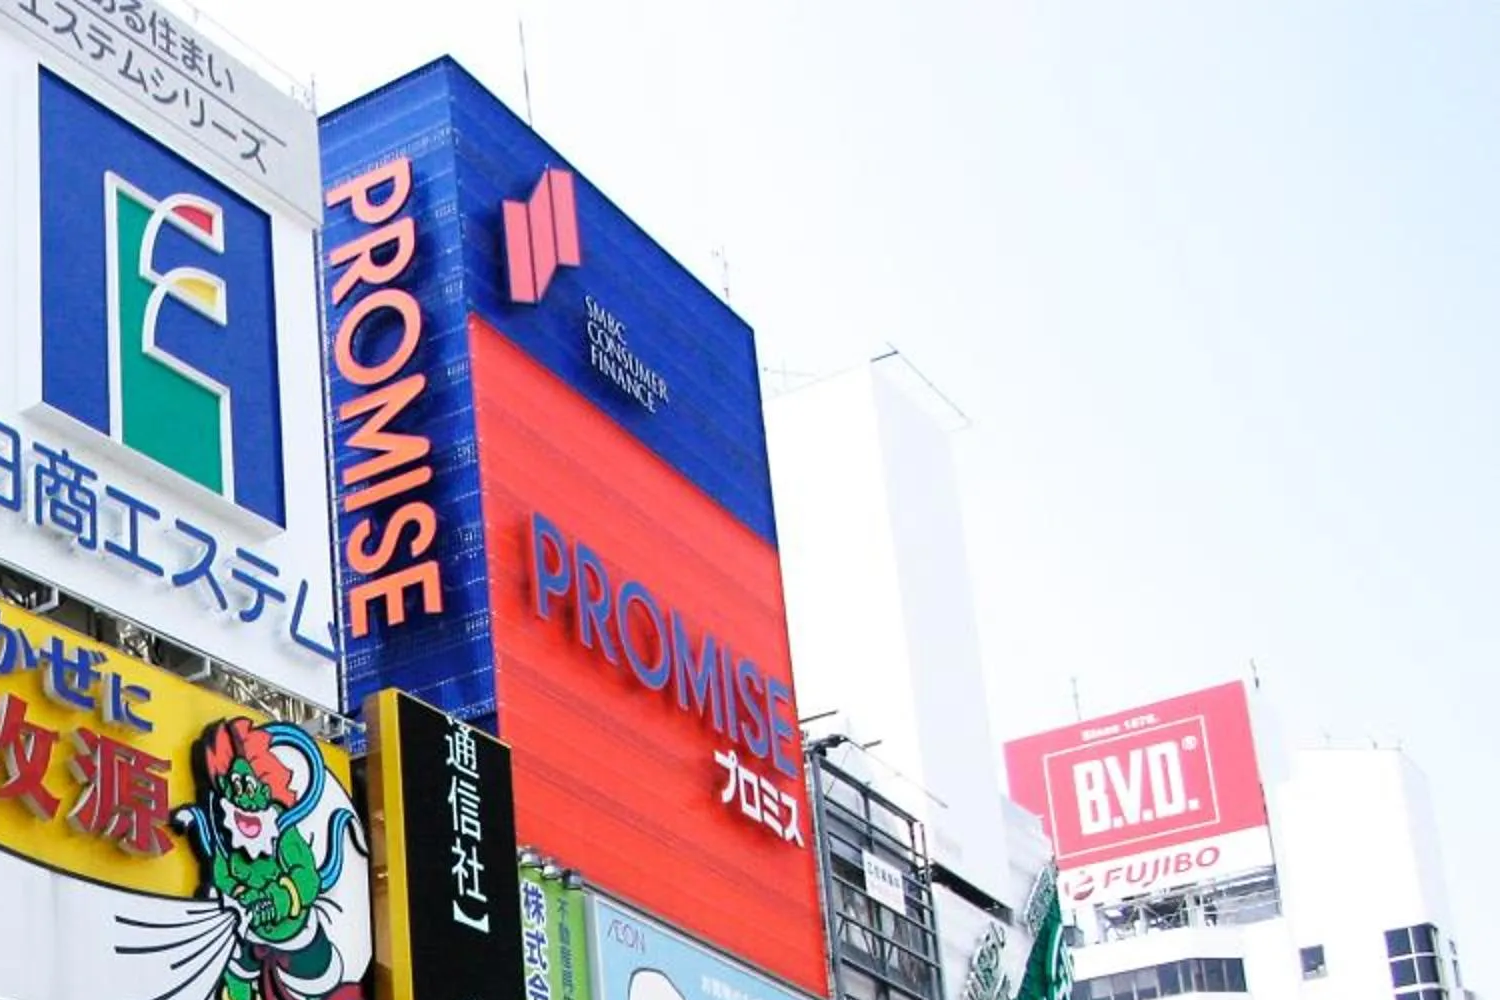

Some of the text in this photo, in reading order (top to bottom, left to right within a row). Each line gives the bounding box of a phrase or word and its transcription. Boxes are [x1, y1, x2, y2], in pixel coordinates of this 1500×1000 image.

[585, 295, 628, 346] SMBC
[588, 320, 669, 404] CONSUMER
[325, 157, 444, 640] PROMISE
[591, 343, 657, 414] FINANCE
[530, 510, 798, 779] PROMISE
[712, 748, 806, 850] プロミス
[1072, 740, 1201, 836] B.V.D.
[1103, 846, 1221, 889] FUJIBO
